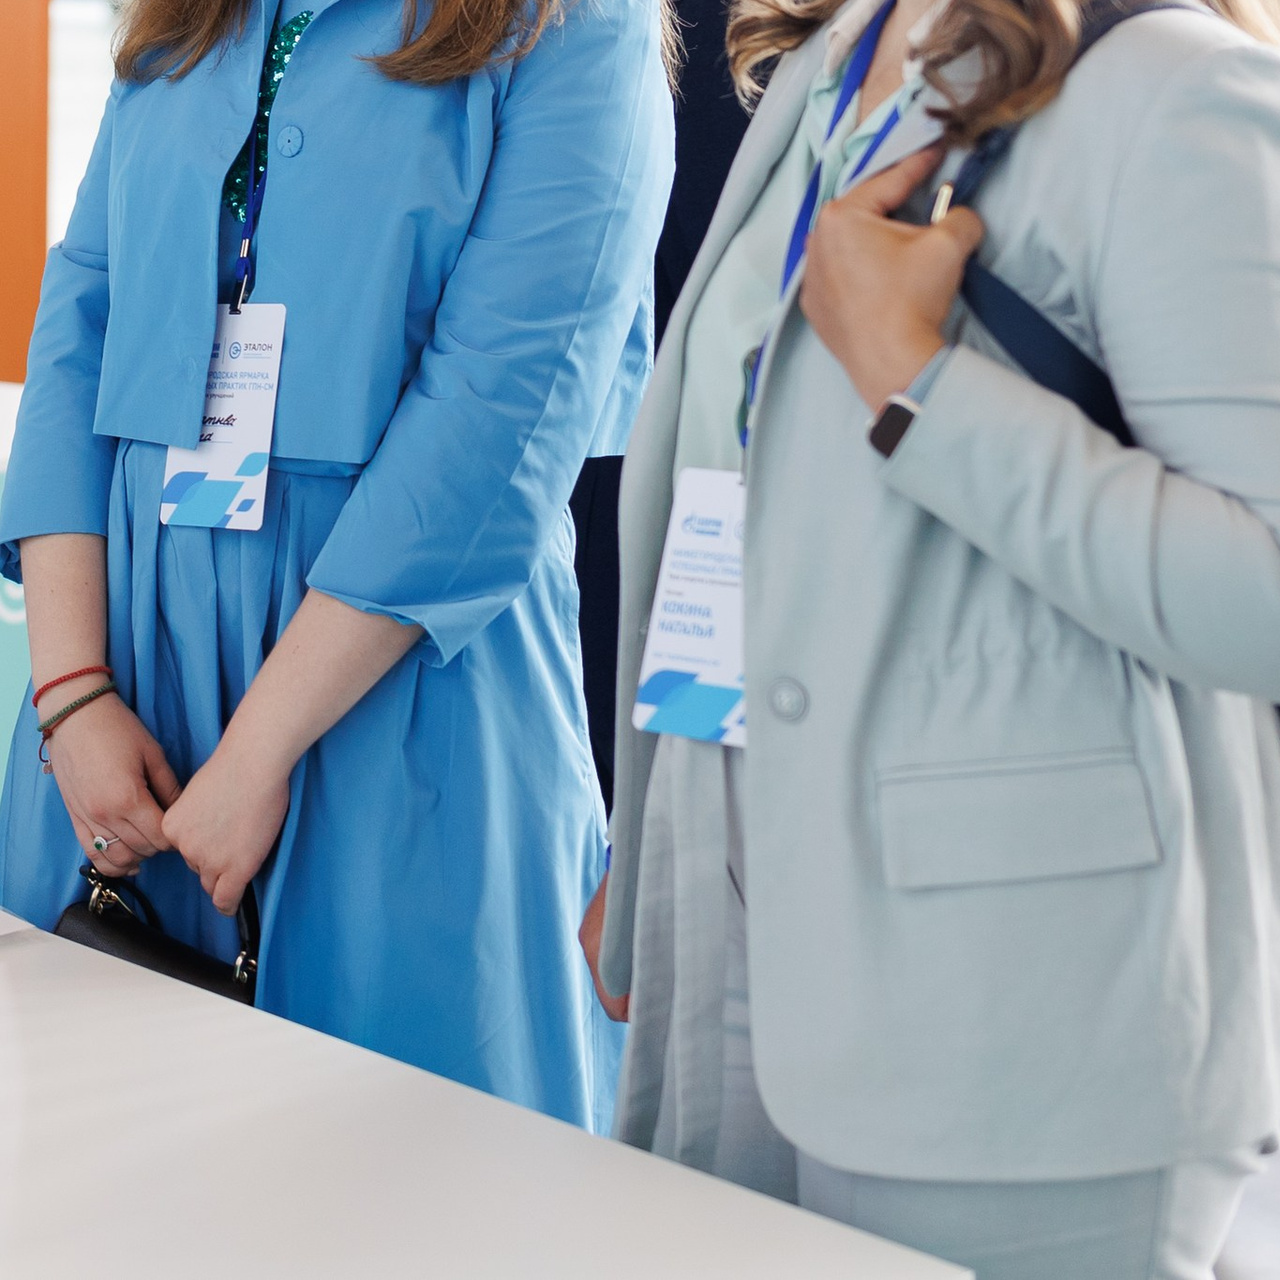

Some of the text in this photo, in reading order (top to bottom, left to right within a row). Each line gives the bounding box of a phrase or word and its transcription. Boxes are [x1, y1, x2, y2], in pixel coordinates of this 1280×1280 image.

[243, 342, 273, 352] ЭТАЛОН
[239, 371, 270, 380] ЯРМАРКА
[219, 382, 247, 390] ПРАКТИК
